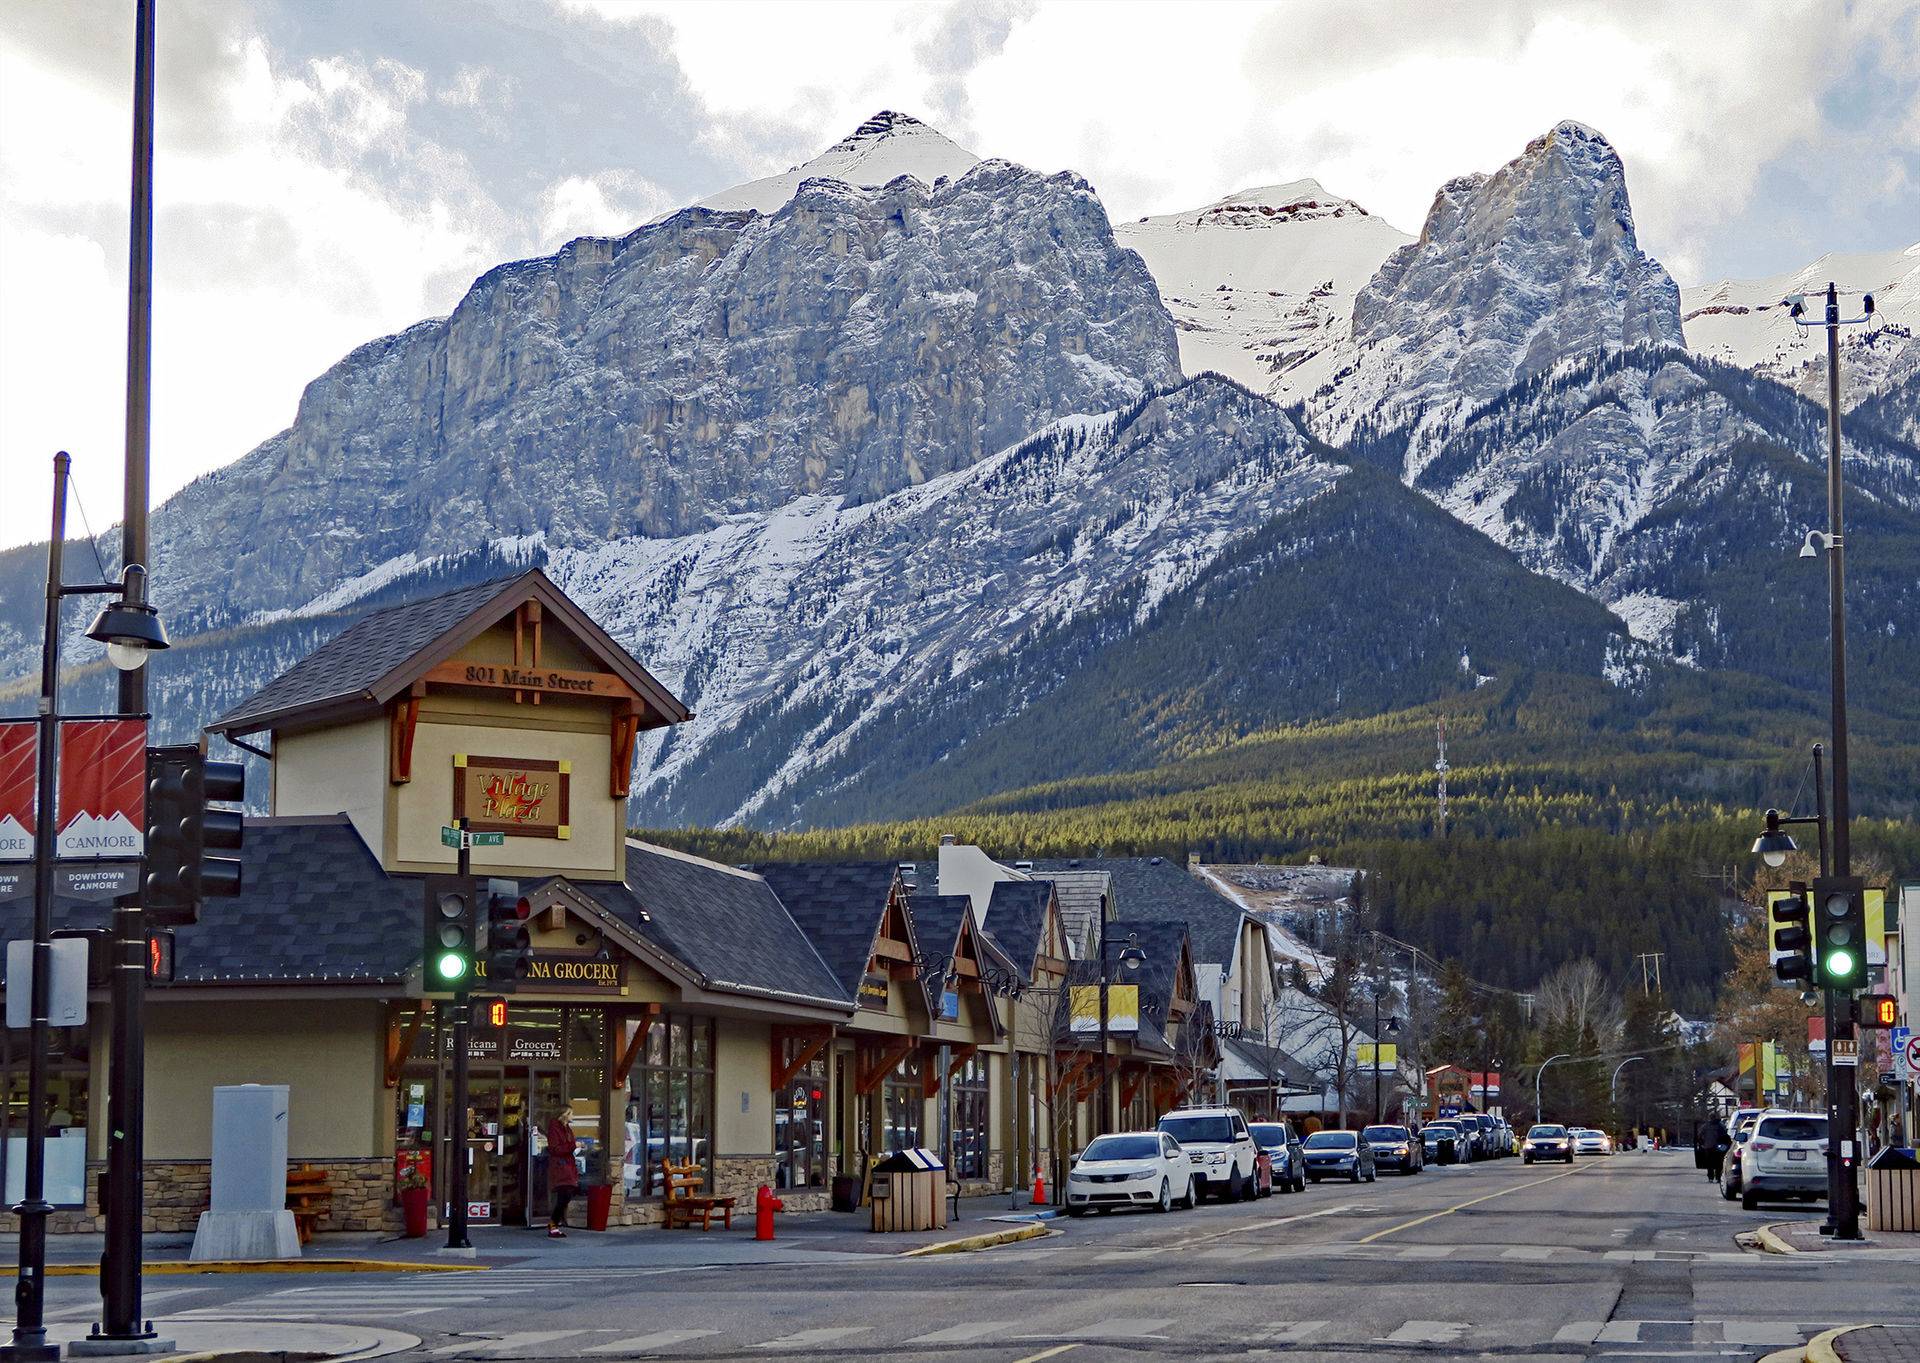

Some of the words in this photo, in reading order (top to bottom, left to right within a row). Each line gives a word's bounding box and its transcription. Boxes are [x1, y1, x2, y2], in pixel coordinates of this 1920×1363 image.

[466, 666, 496, 683] 801
[503, 669, 543, 687] Main
[548, 673, 594, 691] Street
[478, 773, 550, 805] Village
[483, 797, 541, 820] Plaza
[65, 836, 136, 849] CANMORE
[475, 834, 481, 845] 7
[488, 835, 500, 843] AVE
[68, 872, 125, 882] DOWNTOWN
[74, 881, 118, 891] CANMORE
[554, 962, 620, 980] GROCERY
[493, 1003, 504, 1025] 10
[446, 1037, 497, 1049] Ricana
[515, 1038, 556, 1051] Grocery
[469, 1204, 489, 1217] CE
